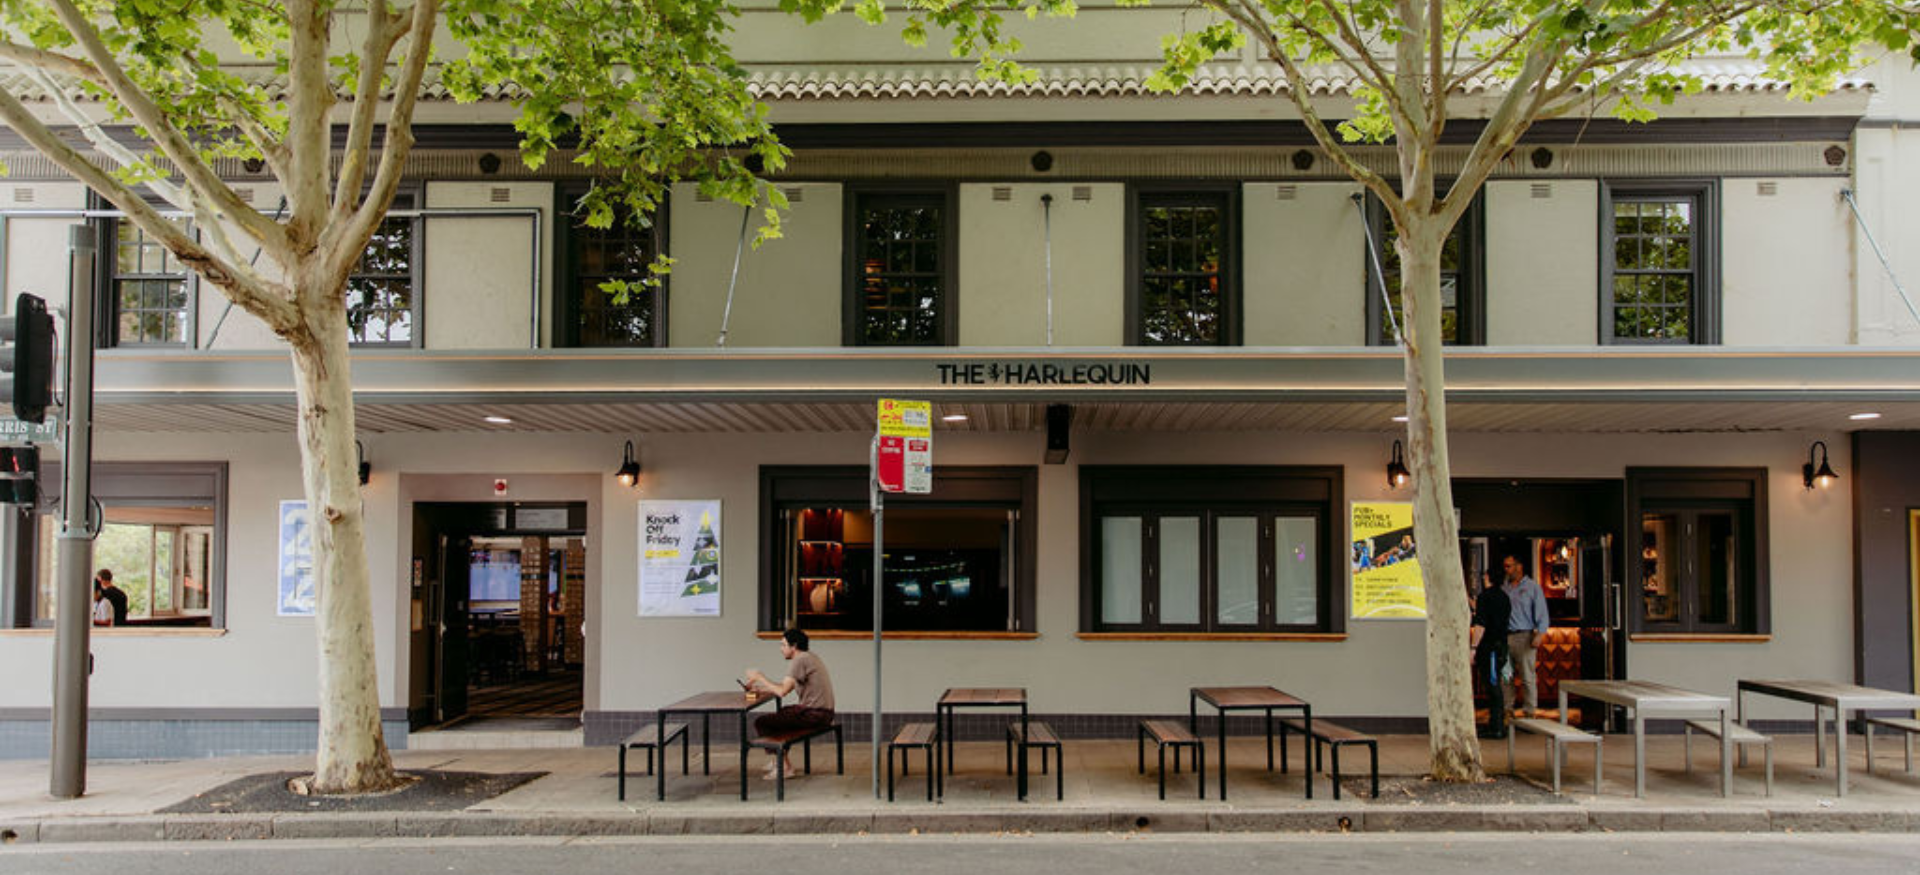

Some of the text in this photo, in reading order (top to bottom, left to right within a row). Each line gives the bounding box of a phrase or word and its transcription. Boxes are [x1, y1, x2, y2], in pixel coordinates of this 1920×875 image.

[937, 364, 1150, 385] THE HARLEQUIN
[646, 514, 680, 525] Knock
[646, 525, 664, 535] Off
[646, 535, 681, 547] Friday
